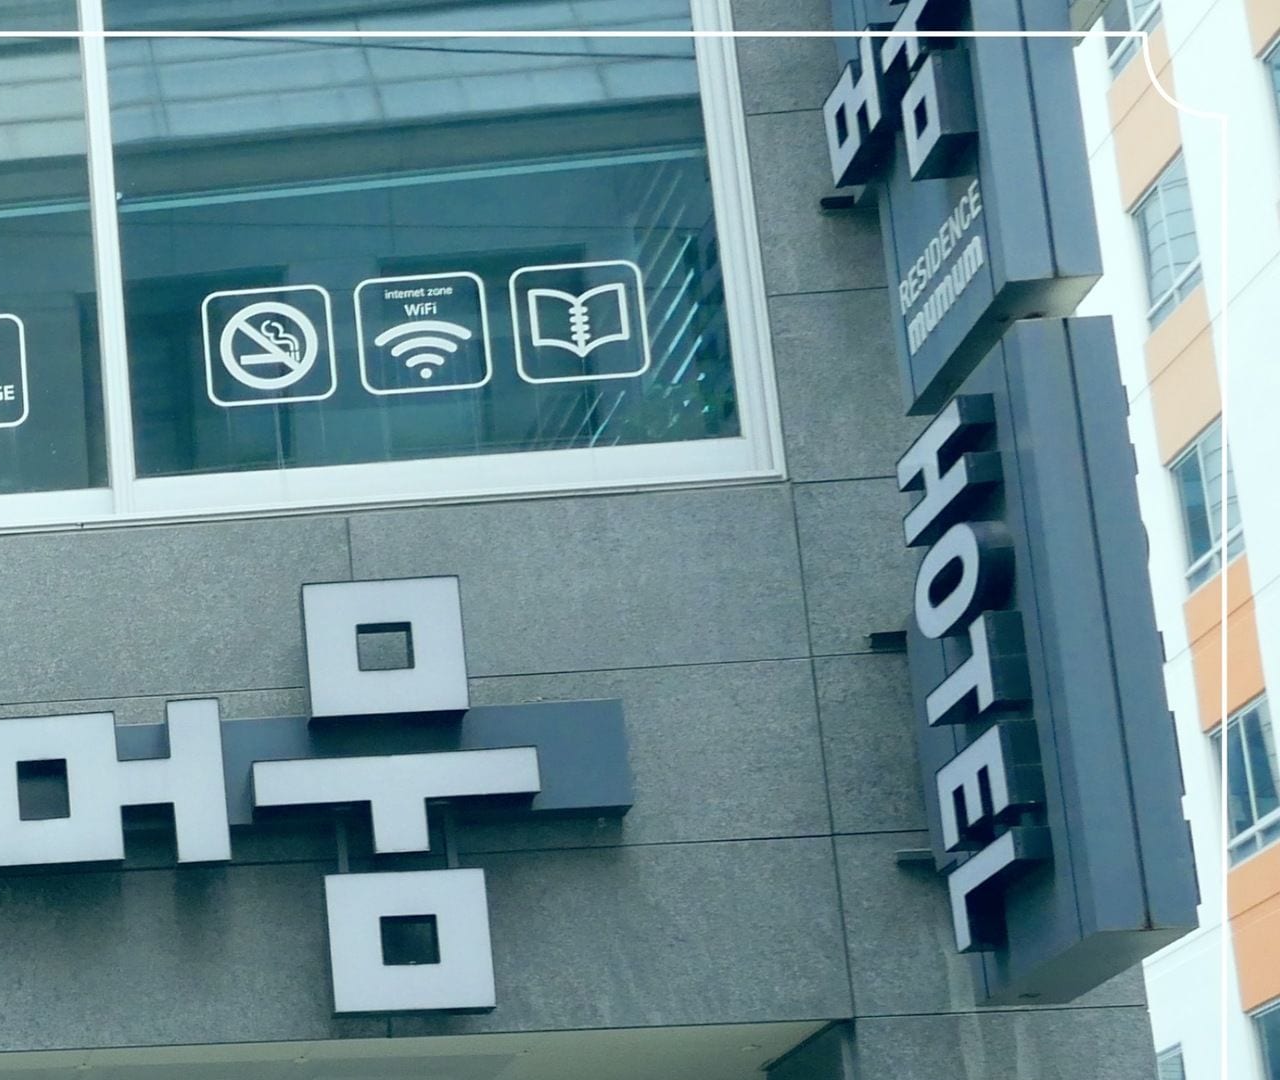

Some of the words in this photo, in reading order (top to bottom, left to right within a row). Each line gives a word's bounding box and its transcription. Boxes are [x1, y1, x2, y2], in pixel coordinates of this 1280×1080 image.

[384, 287, 426, 300] internet
[427, 286, 454, 297] zone
[899, 178, 983, 316] RESIDENCE
[907, 235, 985, 357] mumum
[404, 302, 438, 317] WiFi
[896, 394, 1019, 954] HOTEL
